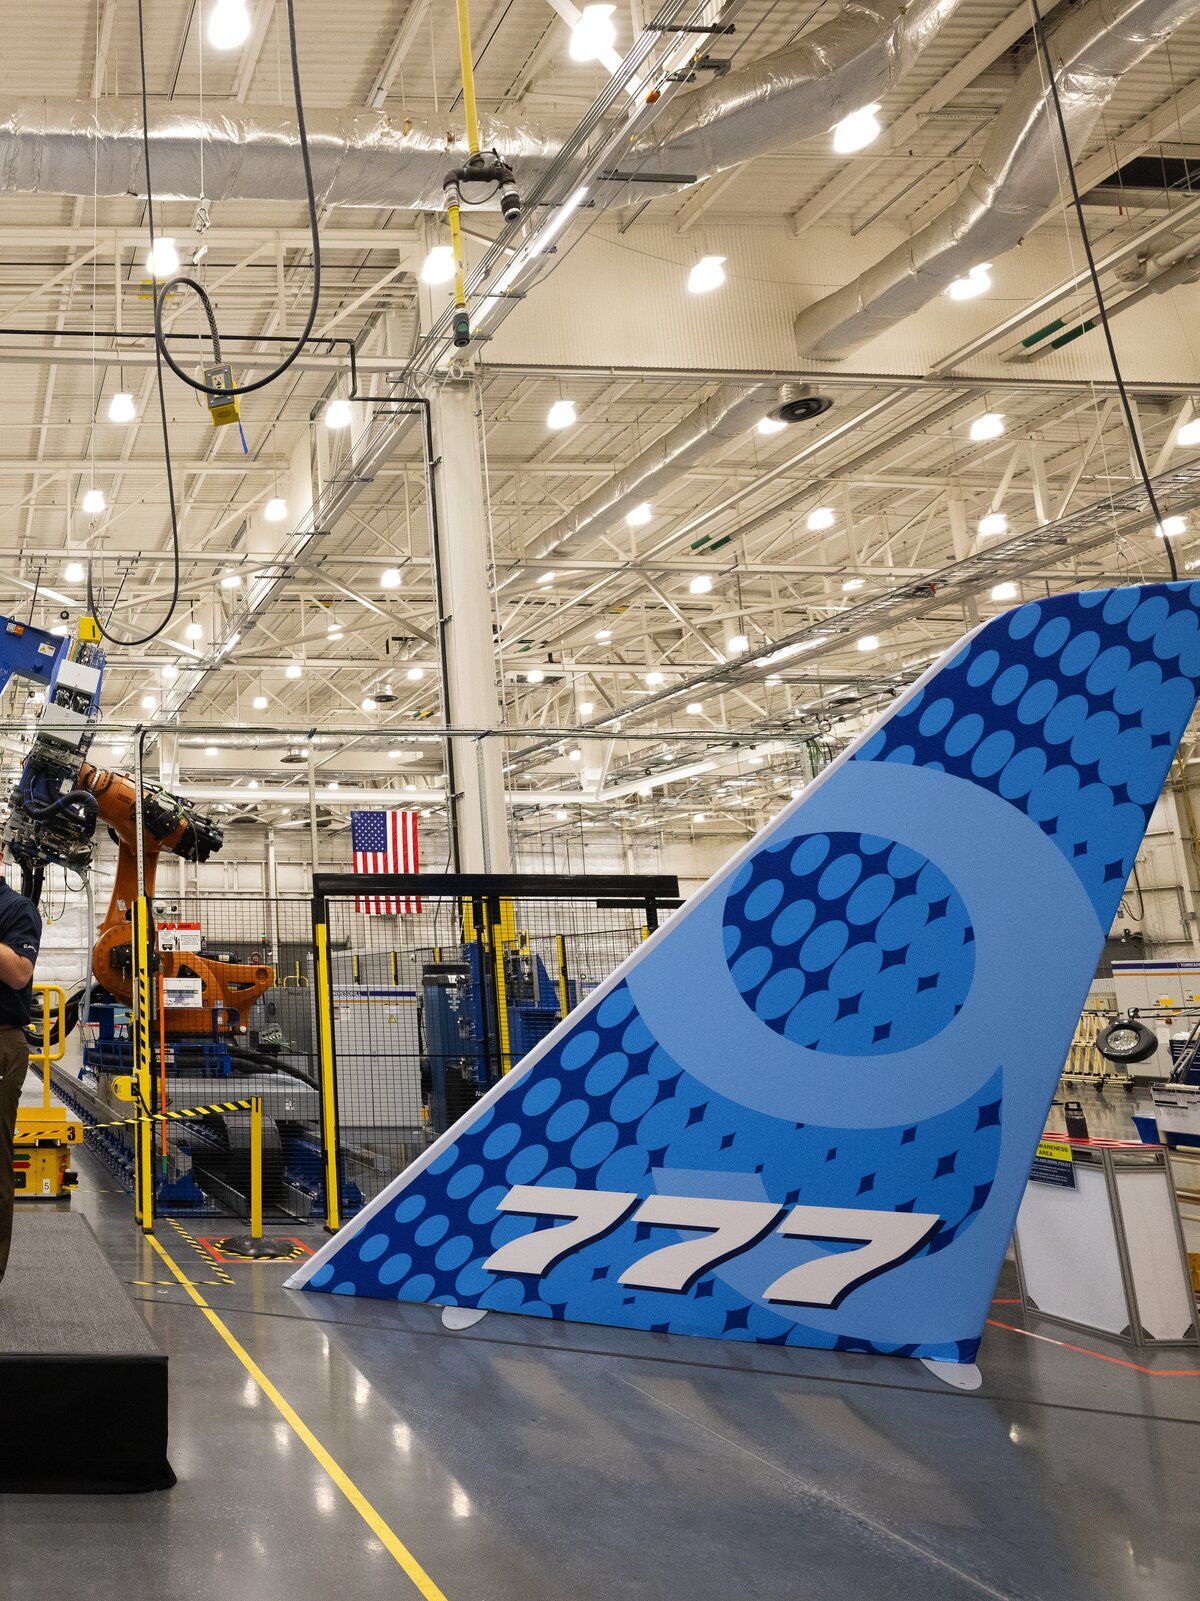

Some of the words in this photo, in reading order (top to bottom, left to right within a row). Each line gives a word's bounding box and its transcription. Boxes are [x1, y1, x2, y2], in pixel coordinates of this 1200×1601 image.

[624, 760, 1102, 1344] 9
[67, 1126, 76, 1141] 3
[1038, 1143, 1069, 1154] WARENESS
[43, 1181, 50, 1191] 5
[482, 1184, 945, 1310] 777
